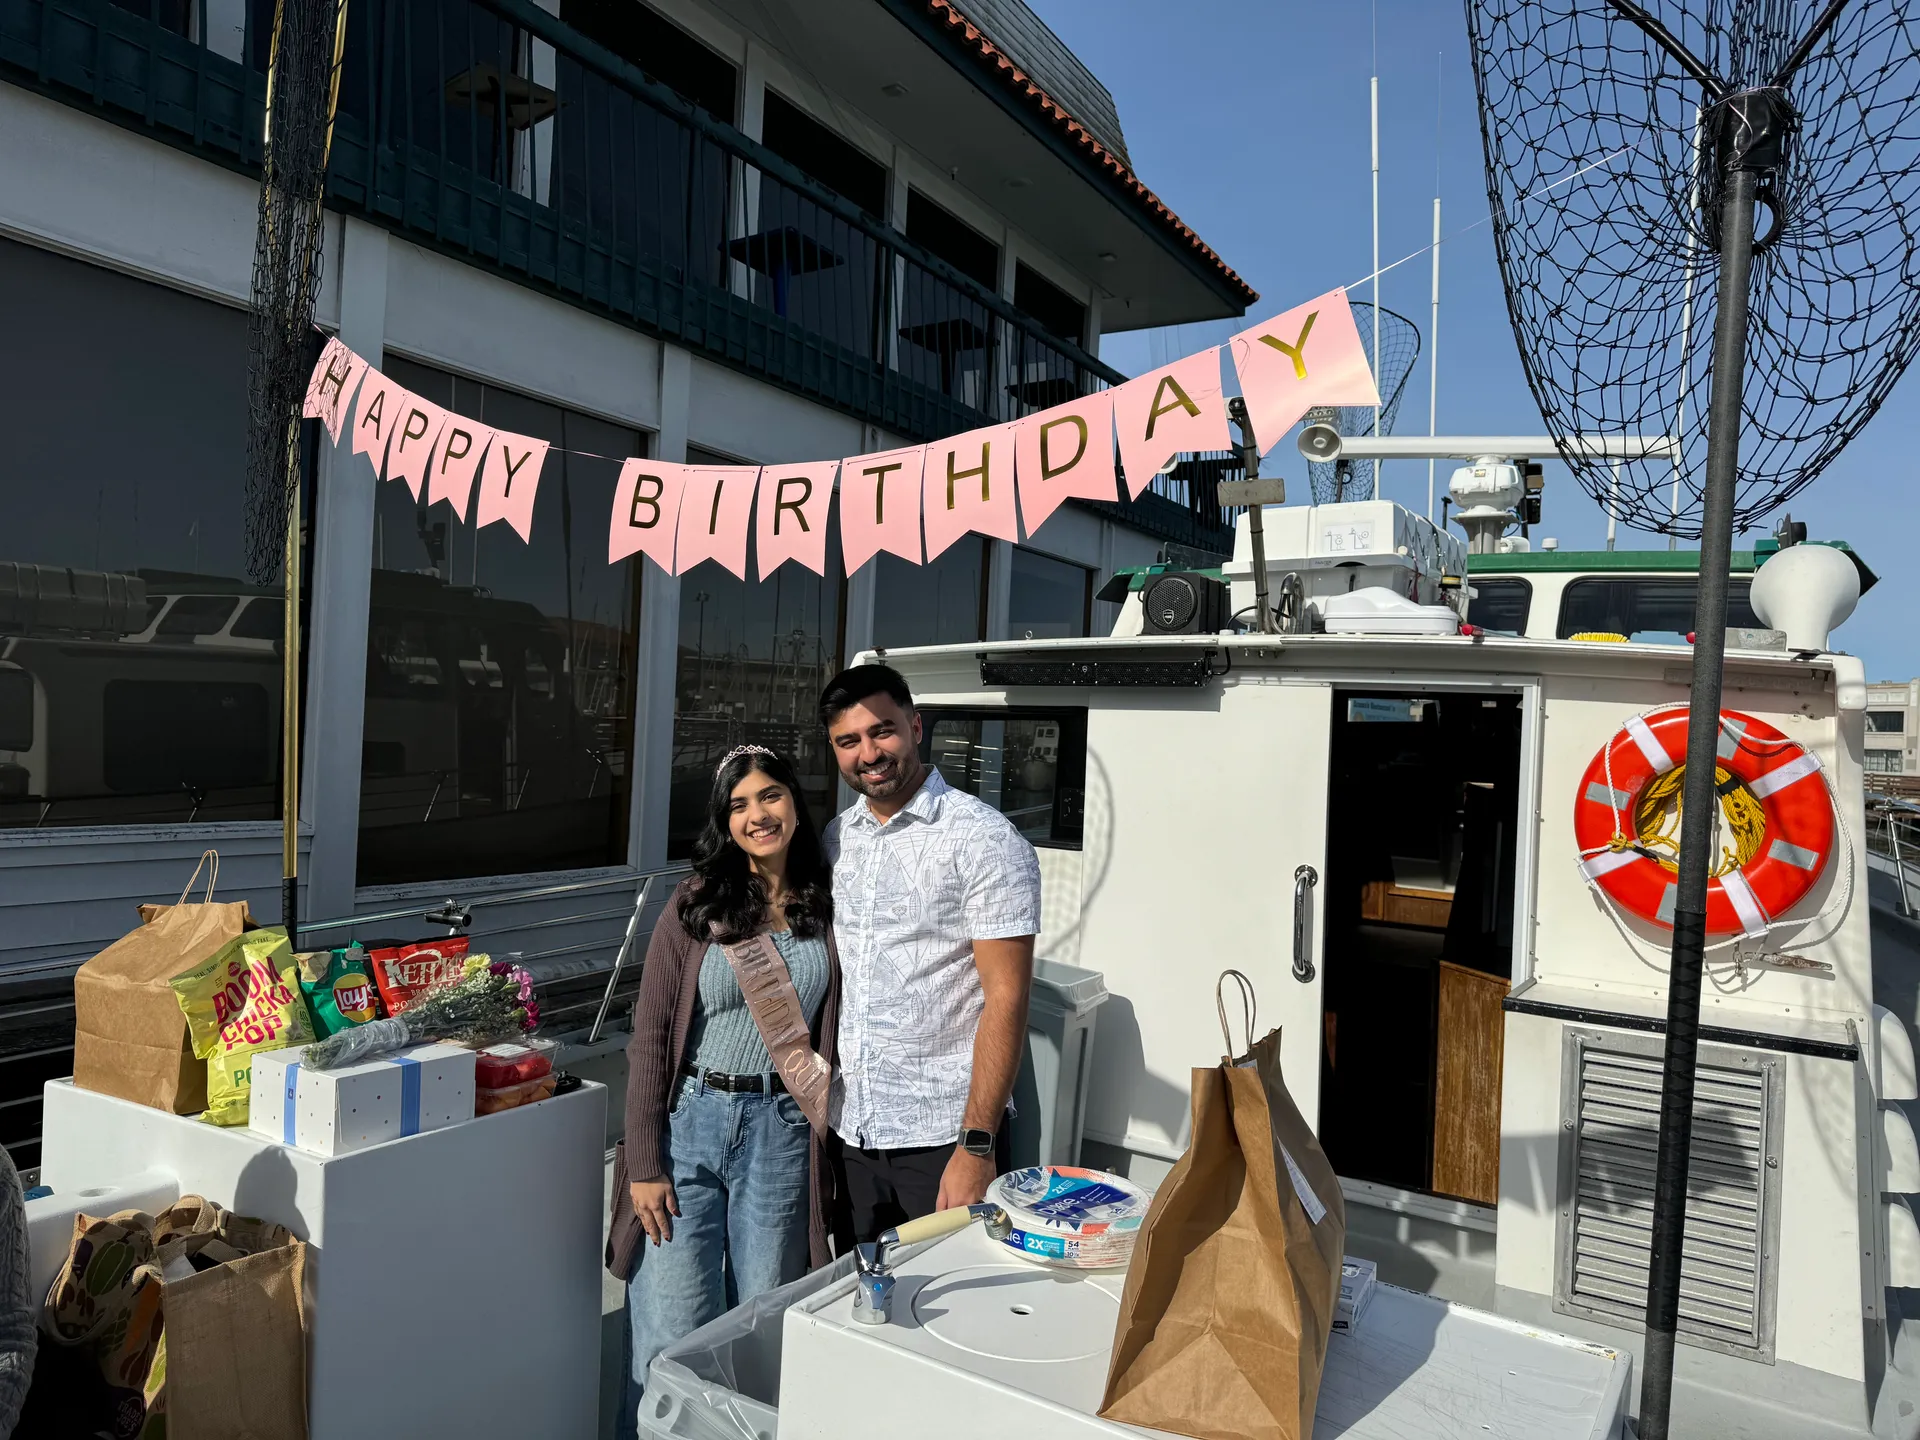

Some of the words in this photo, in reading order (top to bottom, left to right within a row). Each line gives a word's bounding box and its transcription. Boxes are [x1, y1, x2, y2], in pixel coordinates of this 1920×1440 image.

[318, 354, 532, 498] HAPPY
[629, 310, 1320, 535] BIRTHDAY
[212, 956, 284, 1024] BOOM
[219, 985, 297, 1042] CHICKA
[335, 982, 374, 1012] Lay's
[733, 938, 798, 1049] BIRTHDAY
[1027, 1238, 1044, 1251] 2X
[1068, 1240, 1079, 1248] 54
